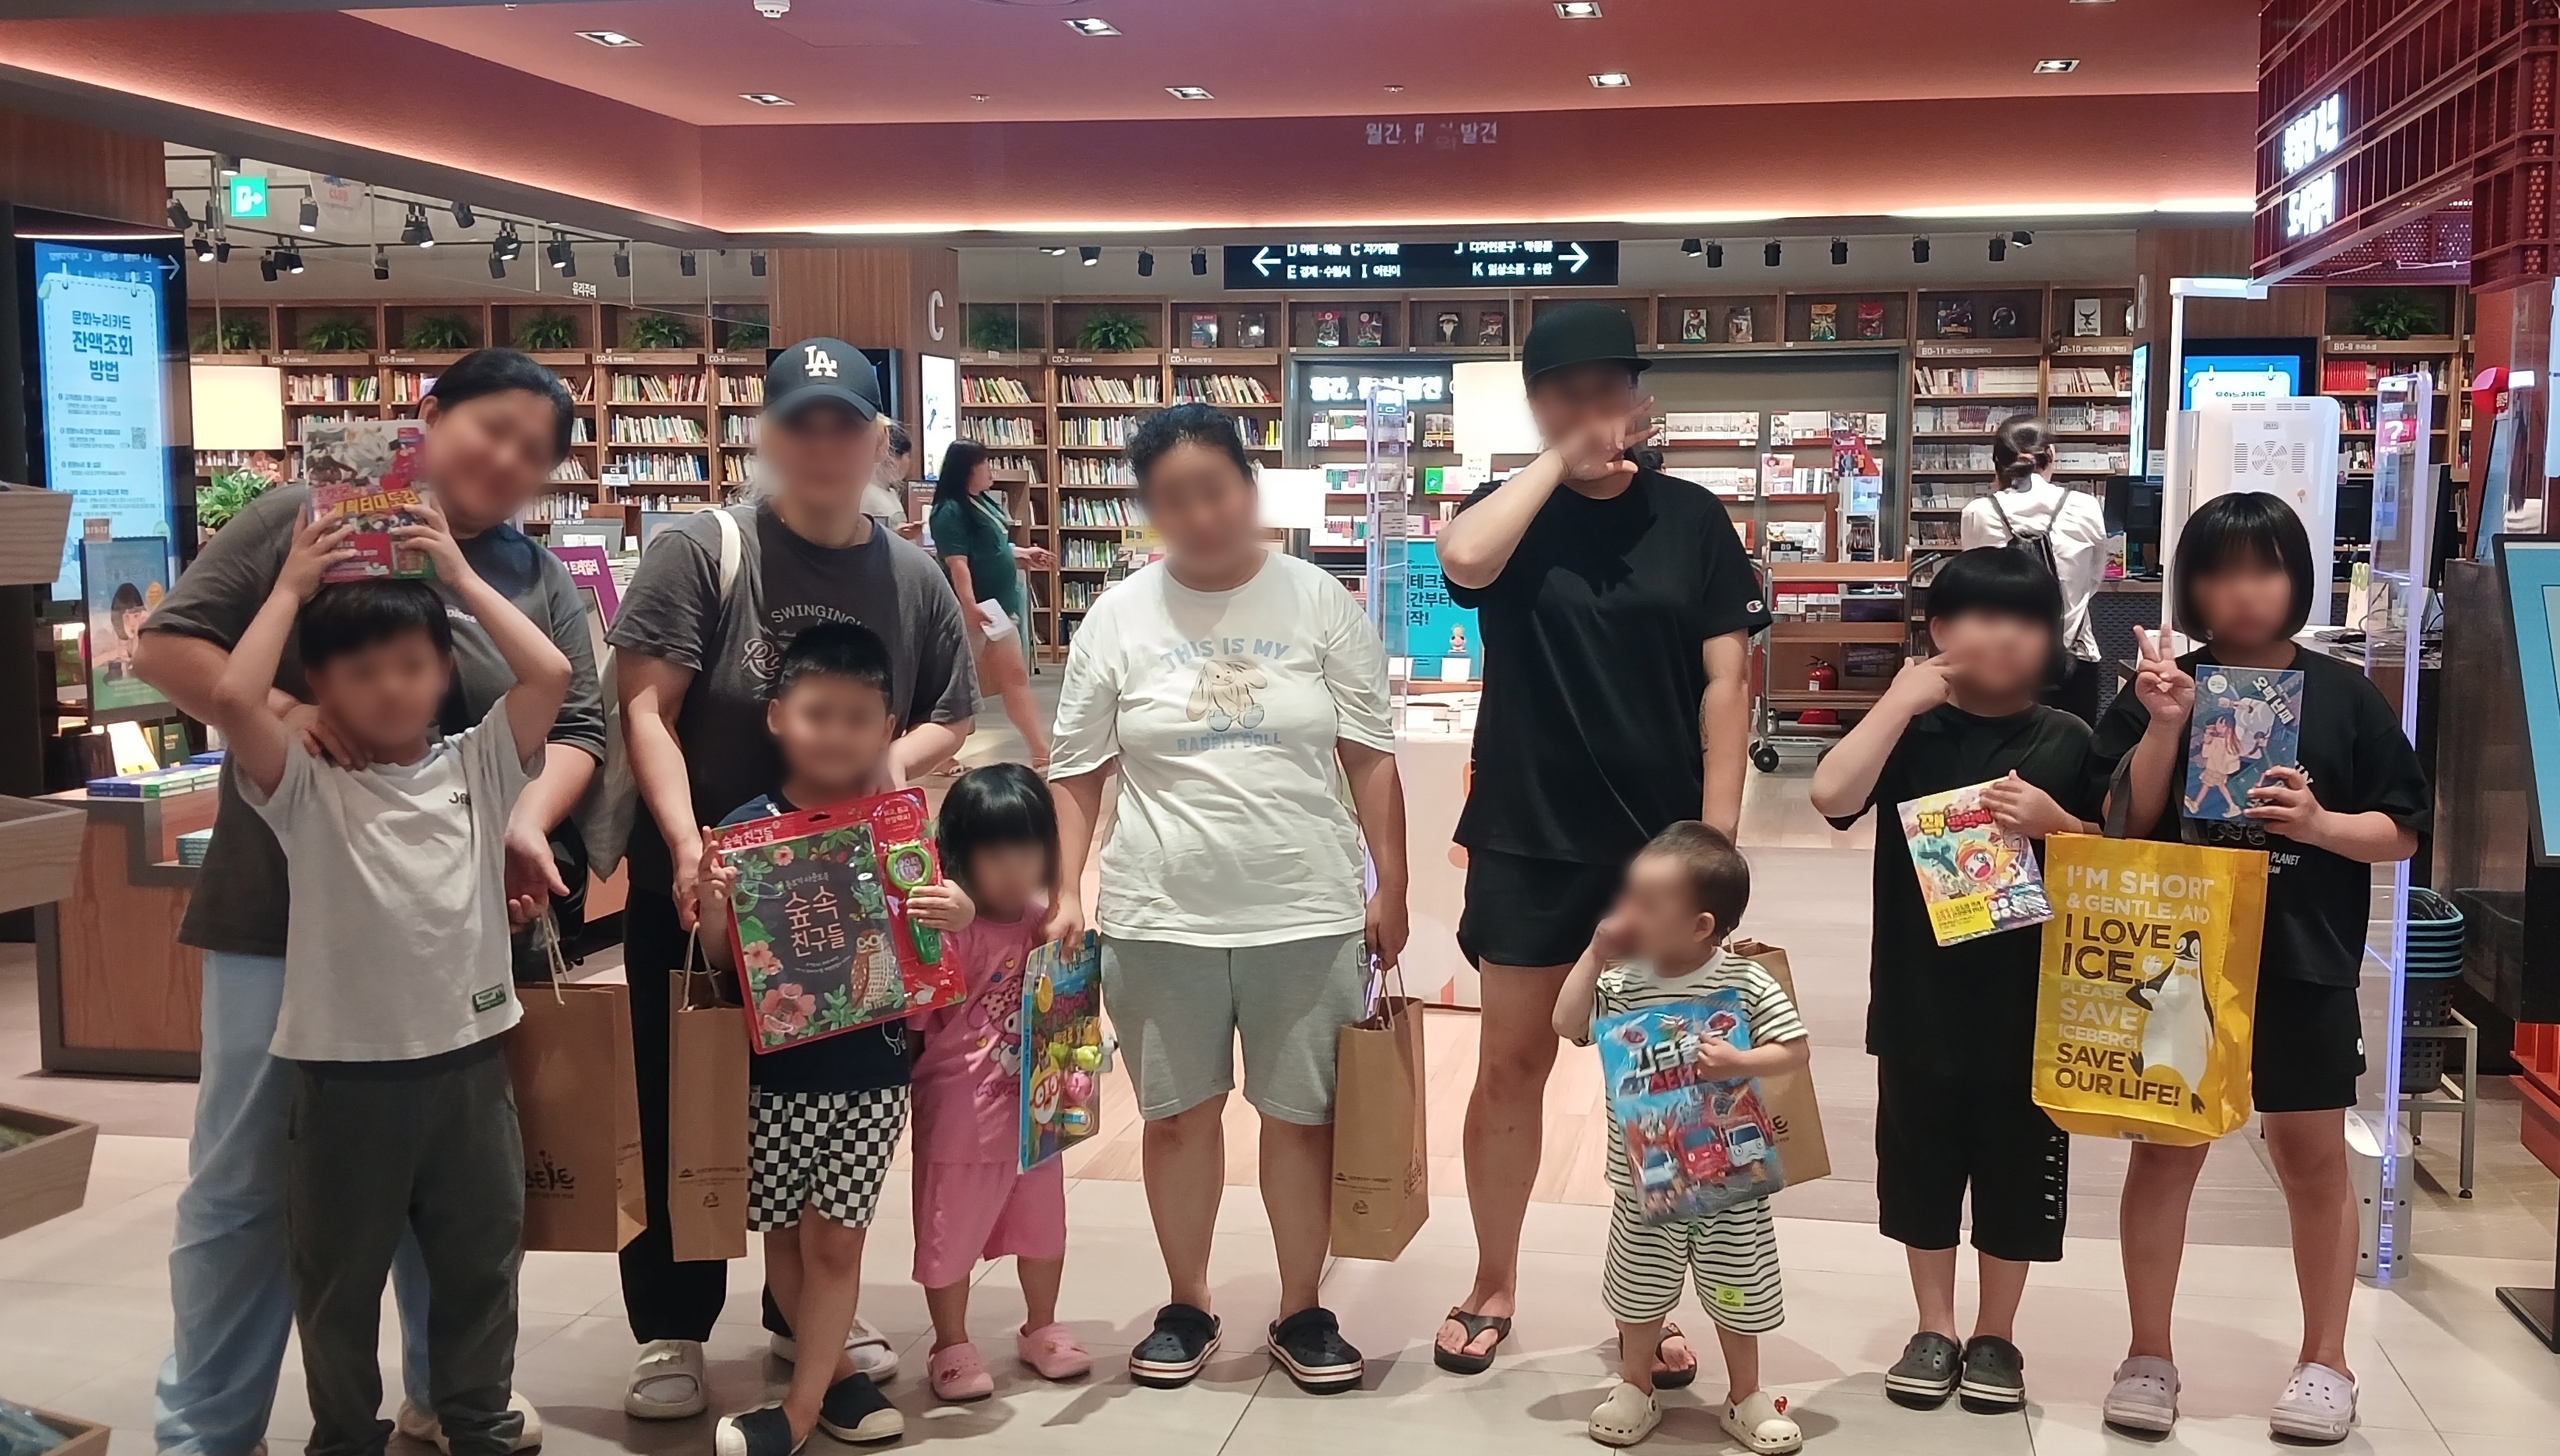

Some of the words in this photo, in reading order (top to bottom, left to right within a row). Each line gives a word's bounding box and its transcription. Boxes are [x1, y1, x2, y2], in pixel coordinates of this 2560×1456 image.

[1287, 243, 1298, 257] D
[1350, 243, 1361, 256] C
[1454, 241, 1463, 254] J
[1287, 264, 1297, 279] E
[1373, 264, 1401, 278] 어린이
[1472, 262, 1483, 276] K
[572, 282, 597, 299] 유리주의
[72, 310, 131, 330] 문화누리카드
[928, 290, 944, 341] C
[72, 331, 133, 356] 잔액조회
[89, 359, 120, 382] 방법
[804, 345, 838, 377] LA
[1160, 640, 1214, 670] THIS
[1223, 637, 1245, 655] IS
[1252, 639, 1290, 660] MY
[2271, 851, 2301, 866] PLANET
[2119, 870, 2215, 902] SHORT
[2066, 892, 2081, 909] &
[2084, 894, 2177, 920] GENTLE.
[2179, 904, 2210, 925] AND
[790, 922, 846, 958] 친구들
[2065, 913, 2073, 938] I
[2082, 916, 2172, 950] LOVE
[2061, 982, 2123, 1002] PLEASE
[2059, 997, 2139, 1031] SAVE
[2057, 1022, 2139, 1050] ICEBERG!
[2056, 1041, 2126, 1073] SAVE
[2054, 1067, 2113, 1096] OUR
[2118, 1077, 2182, 1107] LIFE!
